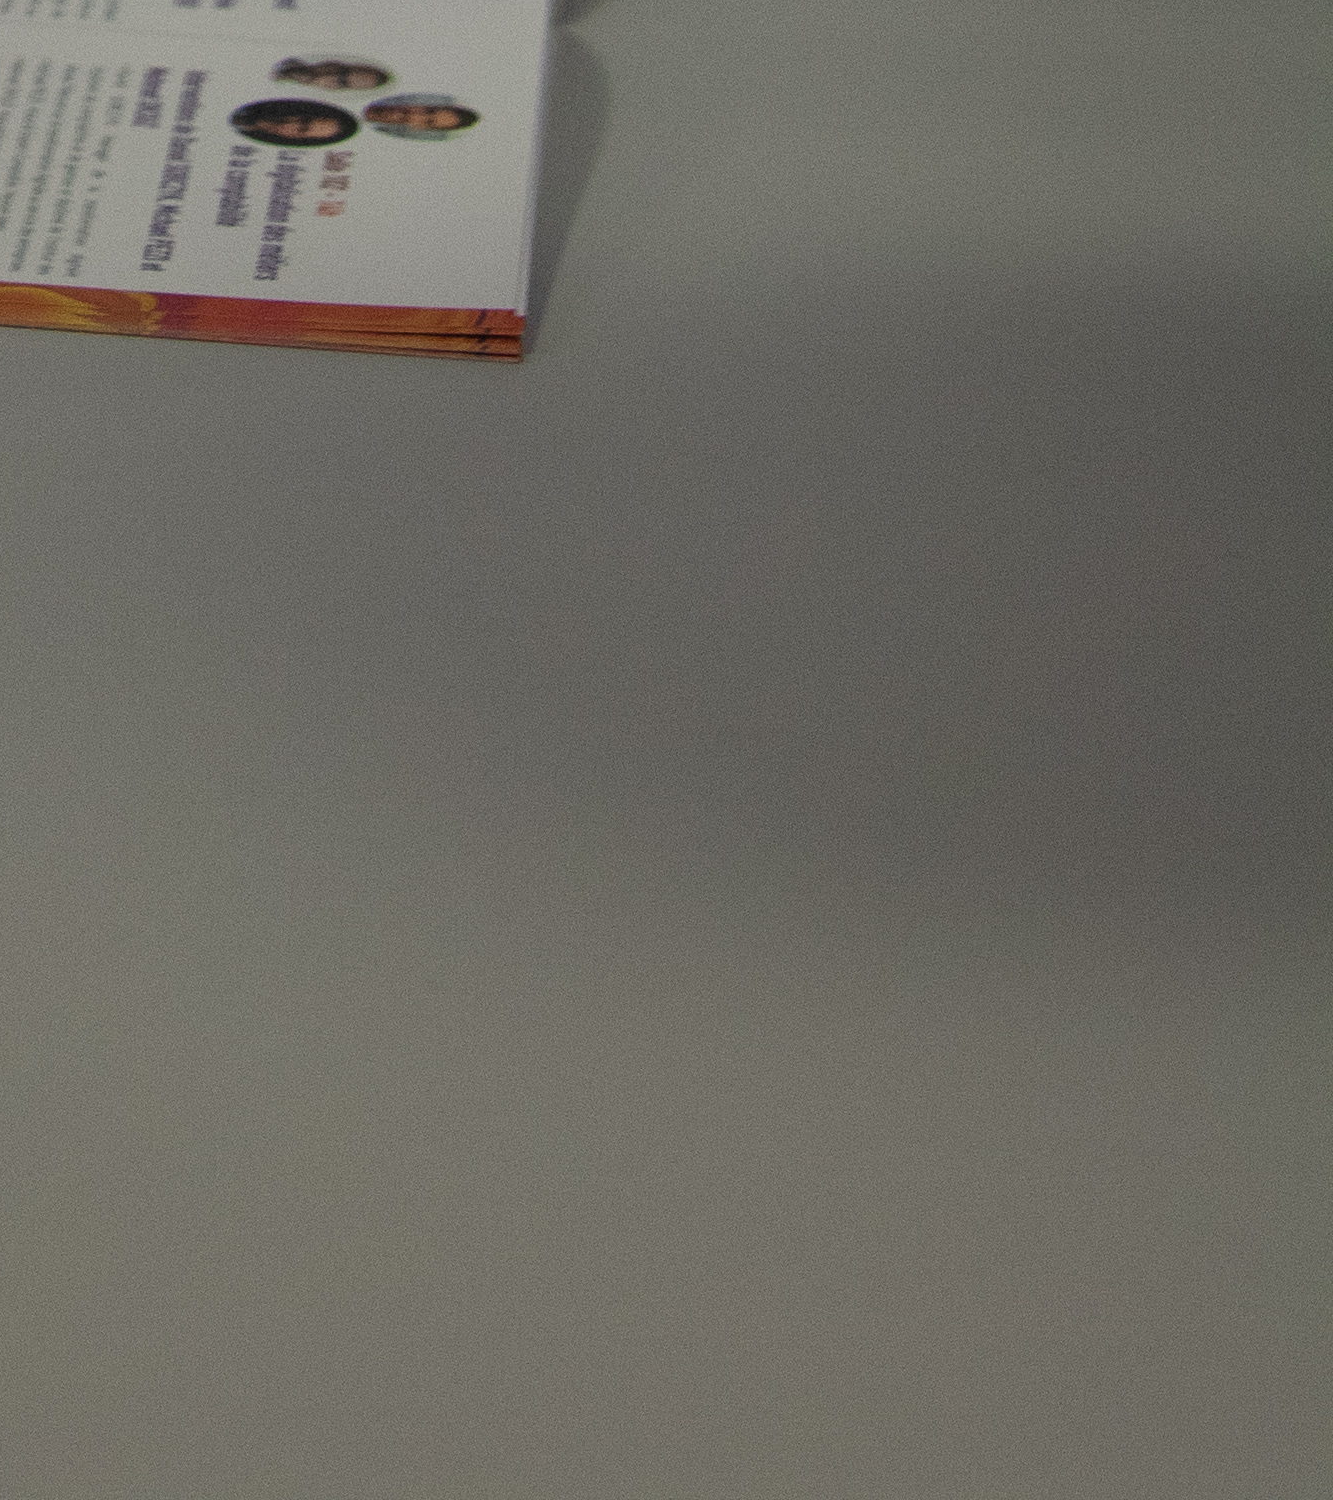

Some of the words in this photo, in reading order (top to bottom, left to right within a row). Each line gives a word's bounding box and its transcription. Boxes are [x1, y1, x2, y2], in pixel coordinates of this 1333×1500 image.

[230, 144, 258, 159] de
[214, 169, 249, 228] comptabilité
[265, 163, 306, 224] digitalisation
[149, 204, 180, 238] Michael
[261, 224, 292, 243] des
